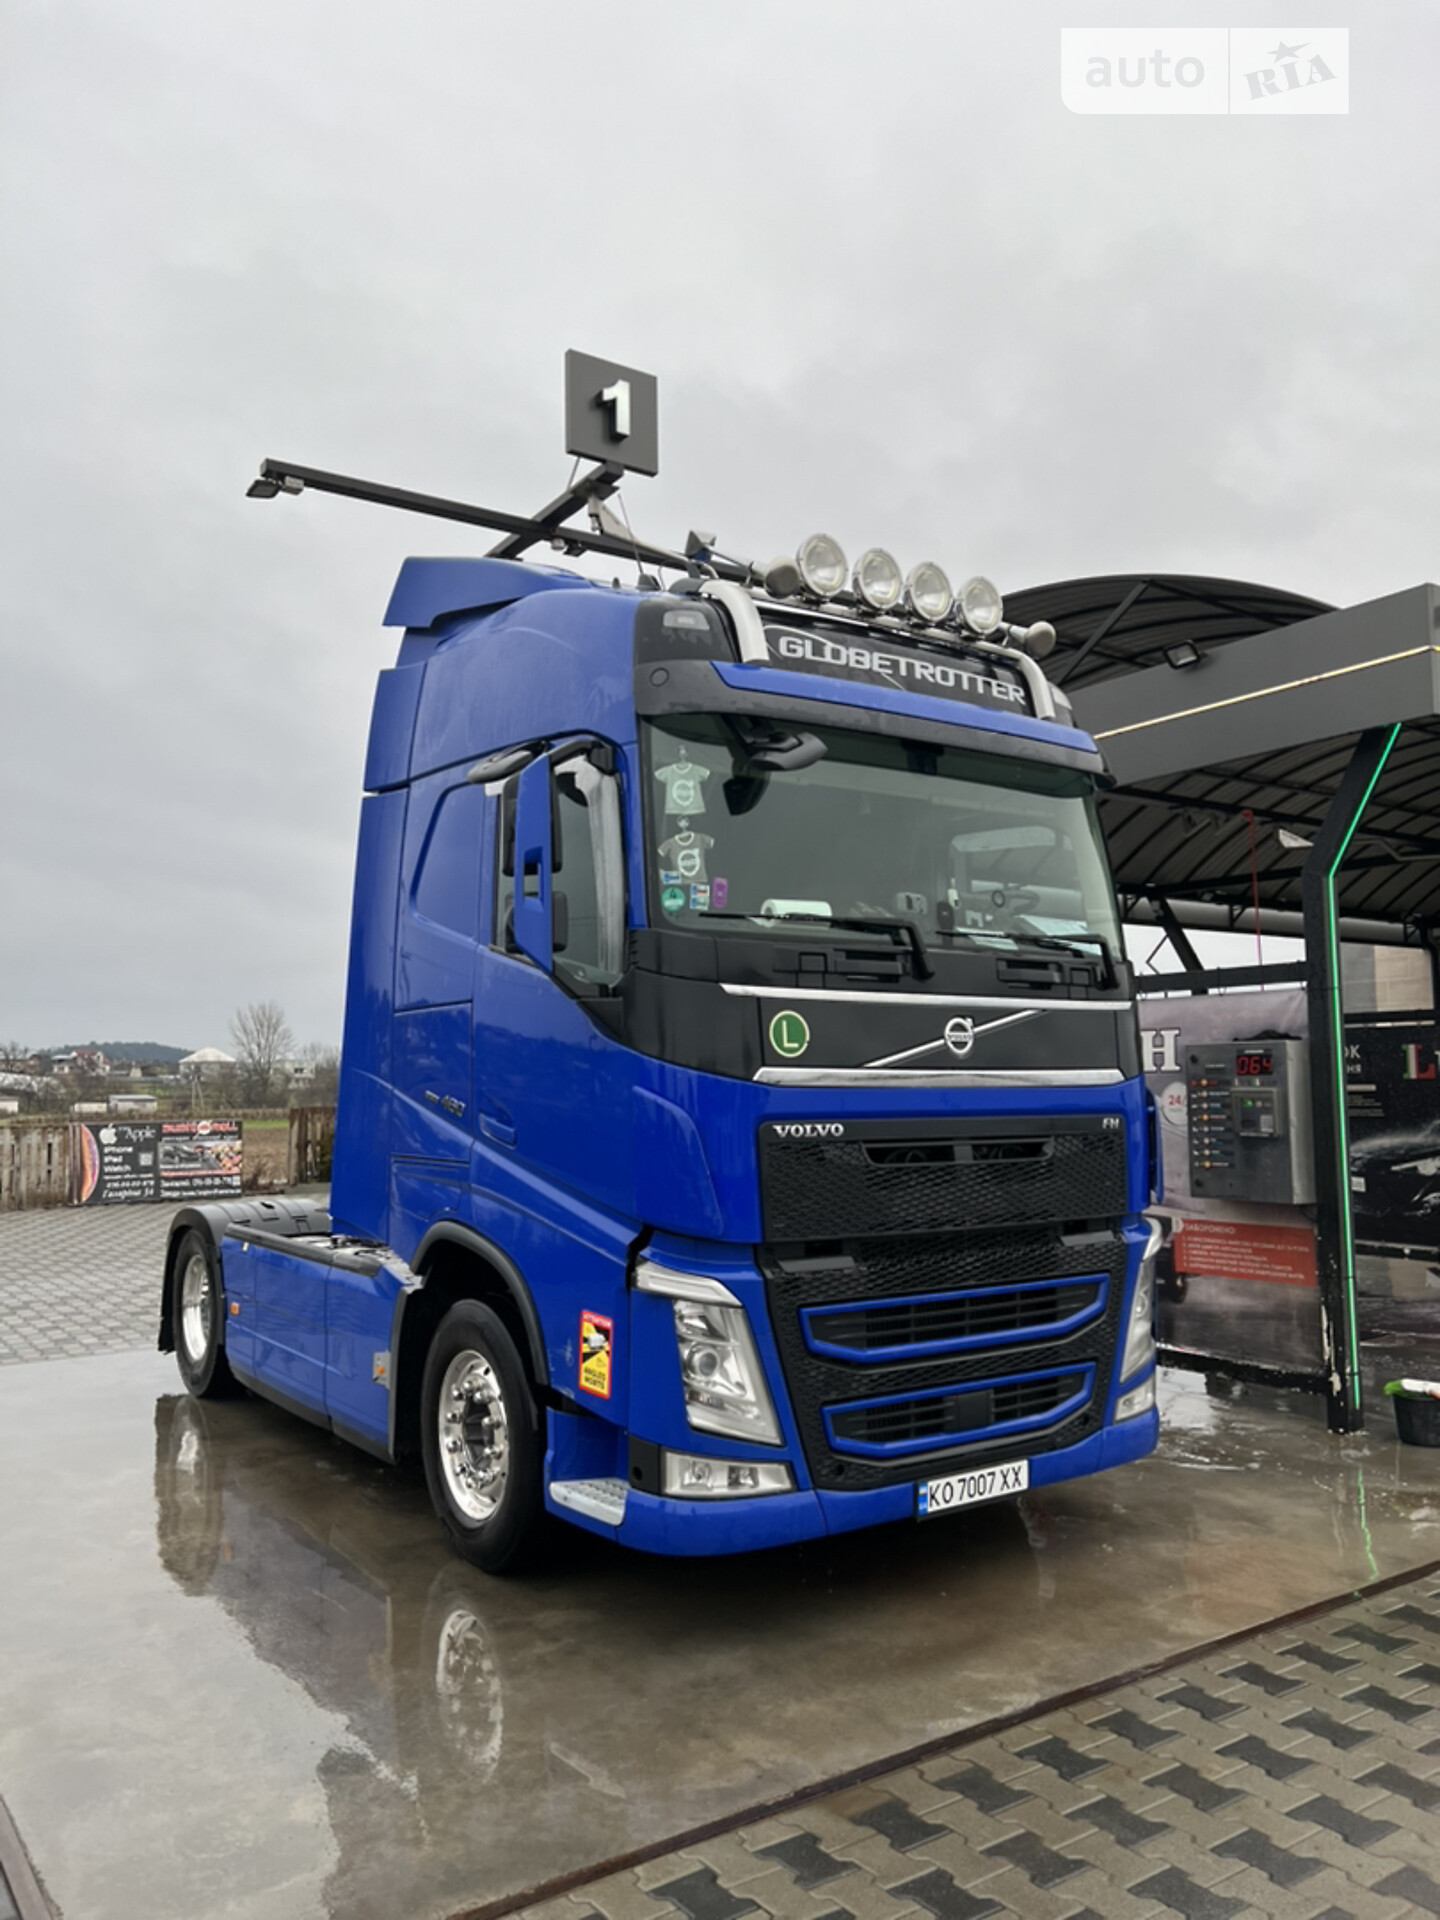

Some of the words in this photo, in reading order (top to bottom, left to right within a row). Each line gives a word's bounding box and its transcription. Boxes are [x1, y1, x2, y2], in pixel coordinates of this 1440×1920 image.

[602, 379, 631, 436] 1
[778, 635, 1026, 705] GLOBETROTTER
[781, 1019, 800, 1049] L
[772, 1122, 846, 1138] VOLVO
[1102, 1117, 1120, 1130] FH
[928, 1481, 954, 1508] KO
[957, 1471, 997, 1502] 7007
[999, 1464, 1023, 1492] XX
